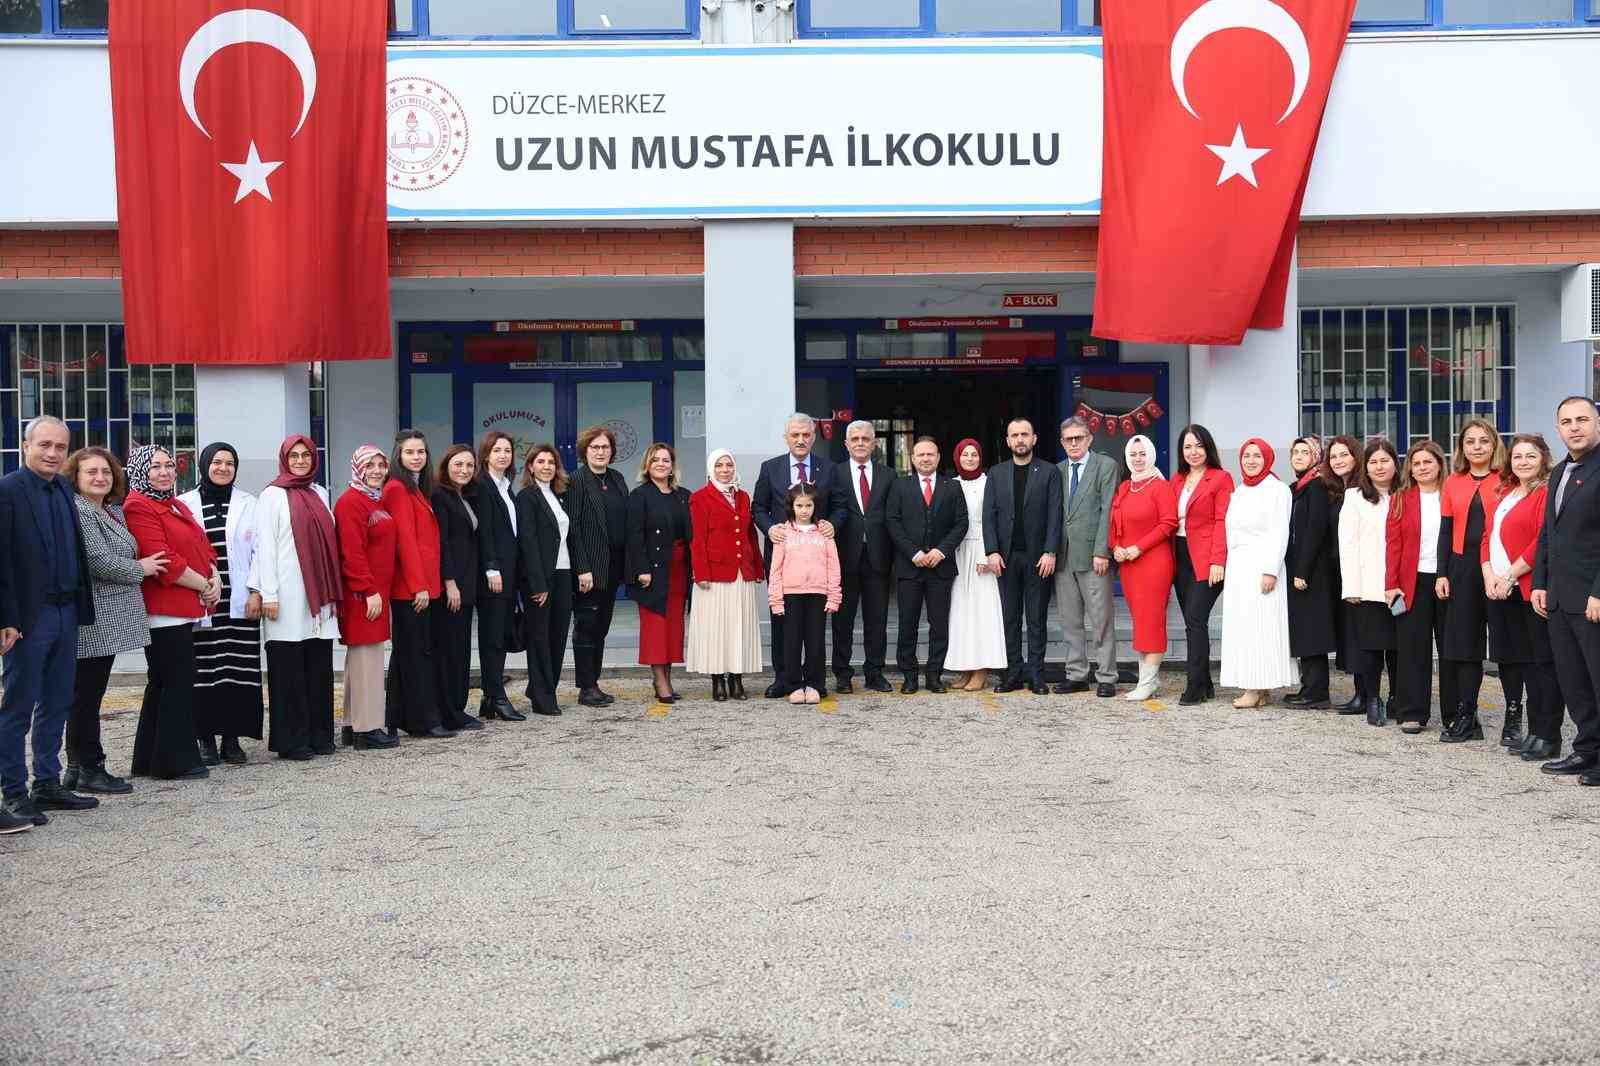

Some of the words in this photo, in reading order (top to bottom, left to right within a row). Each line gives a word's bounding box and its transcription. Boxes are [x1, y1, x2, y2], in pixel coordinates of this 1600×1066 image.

[493, 92, 665, 114] DÜZCE-MERKEZ
[496, 137, 616, 171] UZUN
[632, 135, 833, 169] MUSTAFA
[848, 126, 1059, 166] İLKOKULU
[1004, 296, 1014, 305] A
[1023, 296, 1054, 305] BLOK
[482, 410, 546, 428] OKULUMUZA
